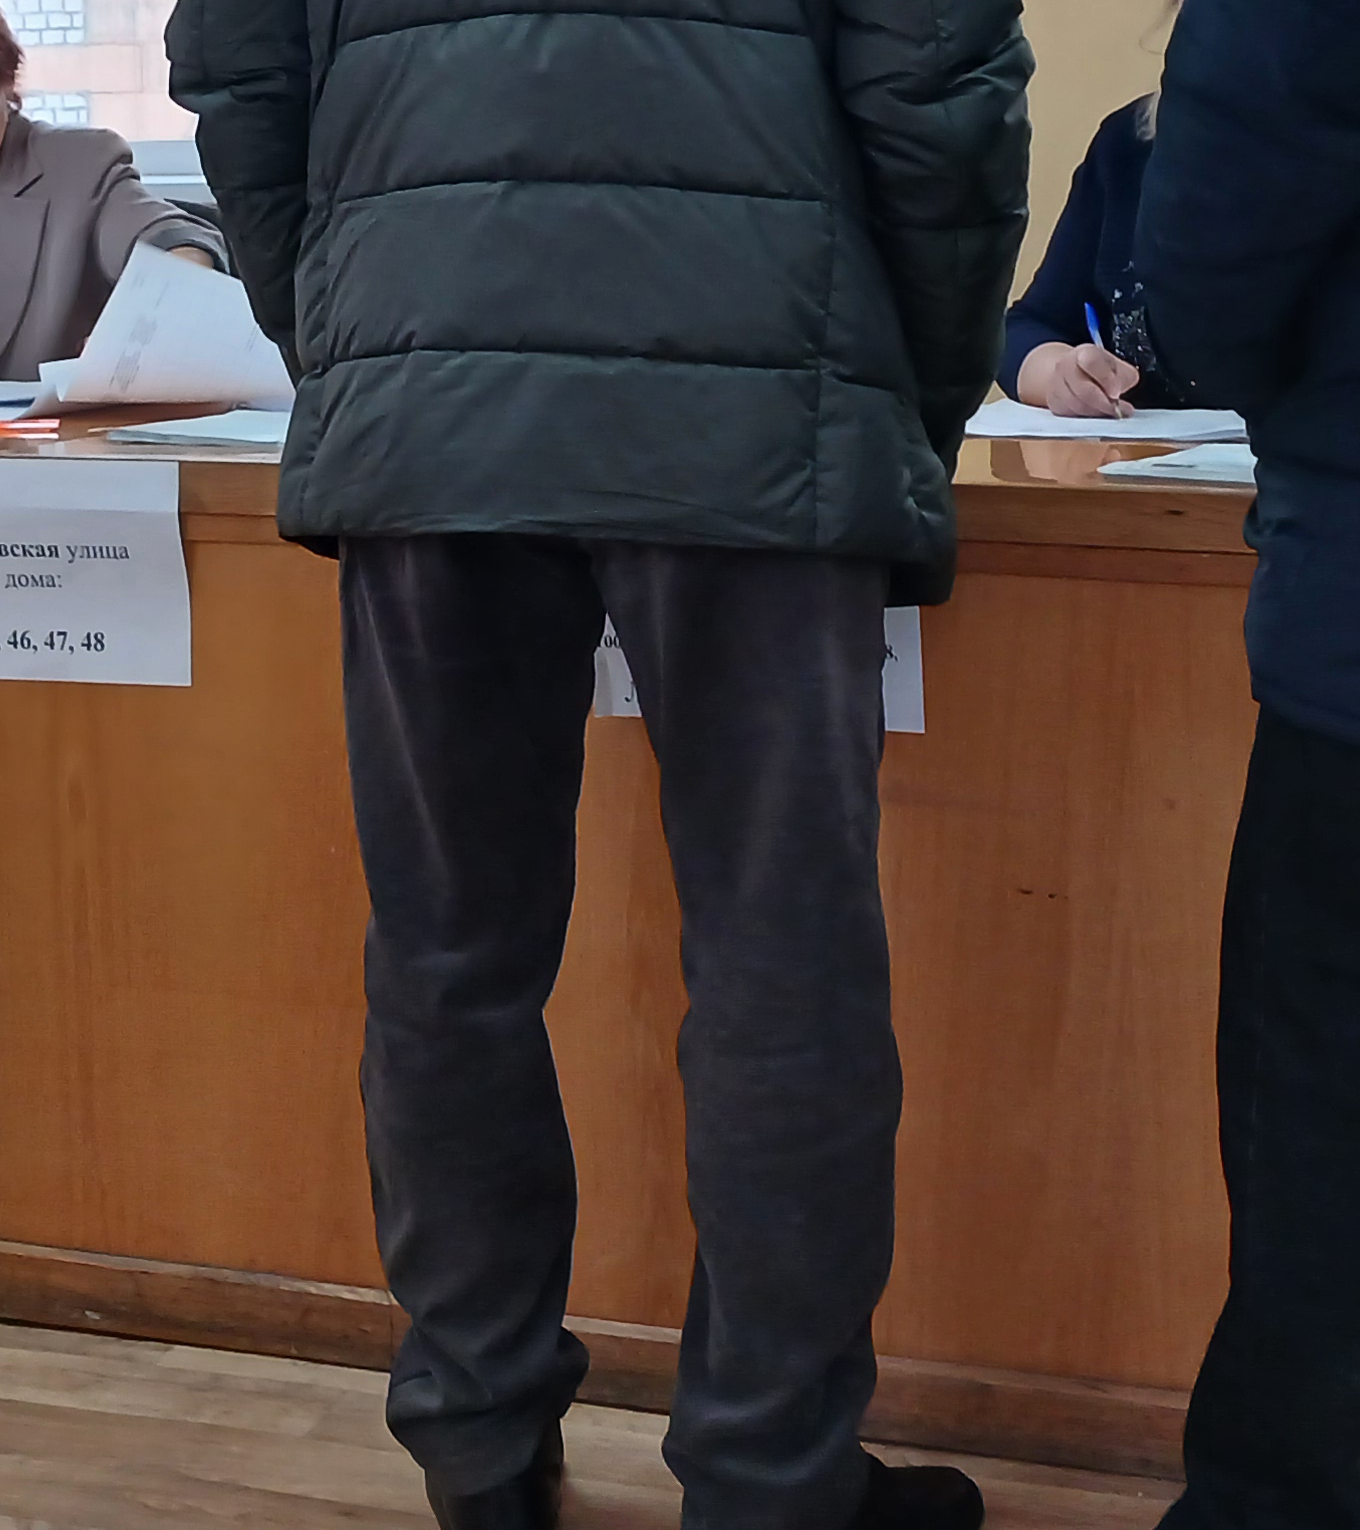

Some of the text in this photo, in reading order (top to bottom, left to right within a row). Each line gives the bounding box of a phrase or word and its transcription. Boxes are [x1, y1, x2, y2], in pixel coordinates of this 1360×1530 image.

[67, 545, 129, 563] улица
[5, 573, 62, 588] дома:
[7, 630, 37, 654] 46,
[44, 631, 74, 654] 47,
[81, 632, 105, 652] 48
